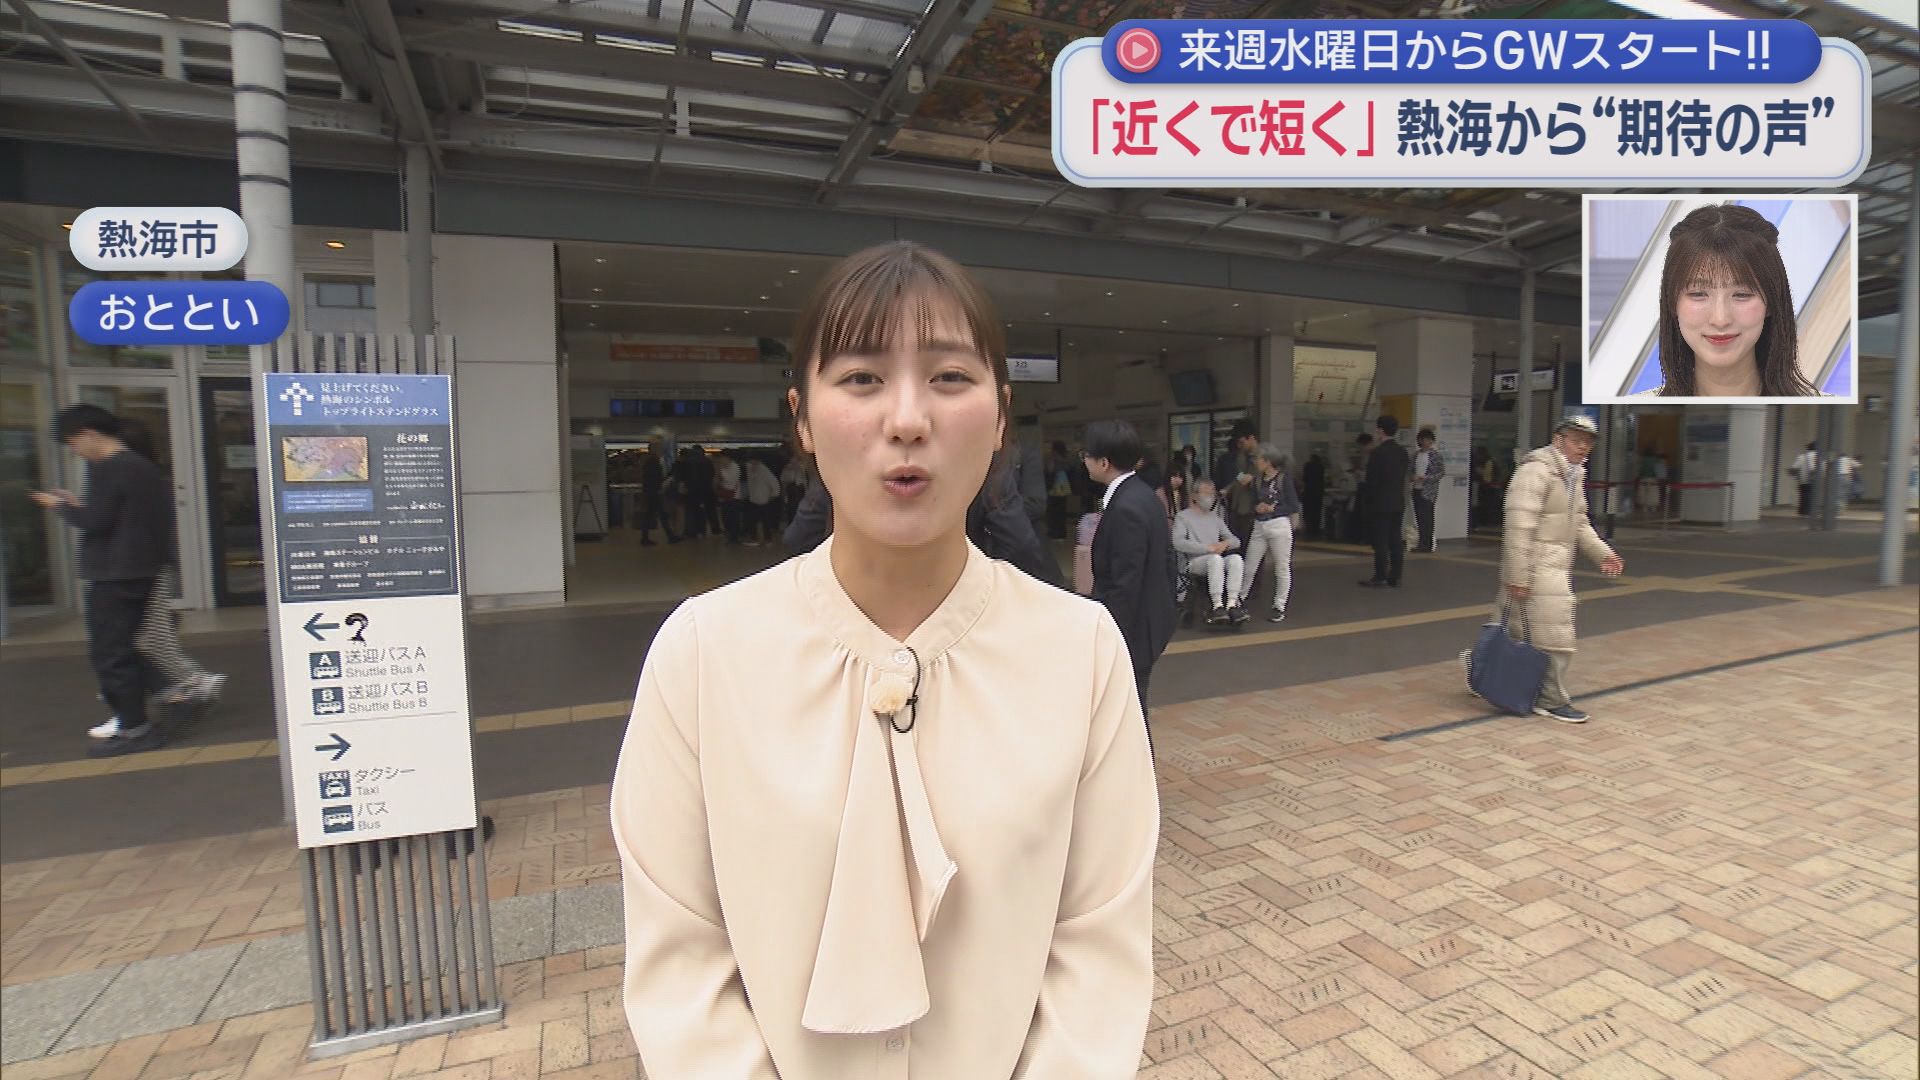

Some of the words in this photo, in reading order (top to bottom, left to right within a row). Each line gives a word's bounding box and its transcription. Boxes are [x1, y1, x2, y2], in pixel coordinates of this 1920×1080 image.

[319, 654, 333, 666] A
[345, 666, 388, 678] Shuttle
[391, 664, 414, 675] Bus
[416, 663, 426, 673] A
[321, 689, 335, 702] B
[348, 702, 390, 714] Shuttle
[393, 700, 416, 710] Bus
[419, 698, 428, 708] B
[354, 766, 417, 784] タクシー
[357, 785, 380, 796] Taxi
[357, 801, 390, 817] バス
[358, 820, 382, 831] Bus
